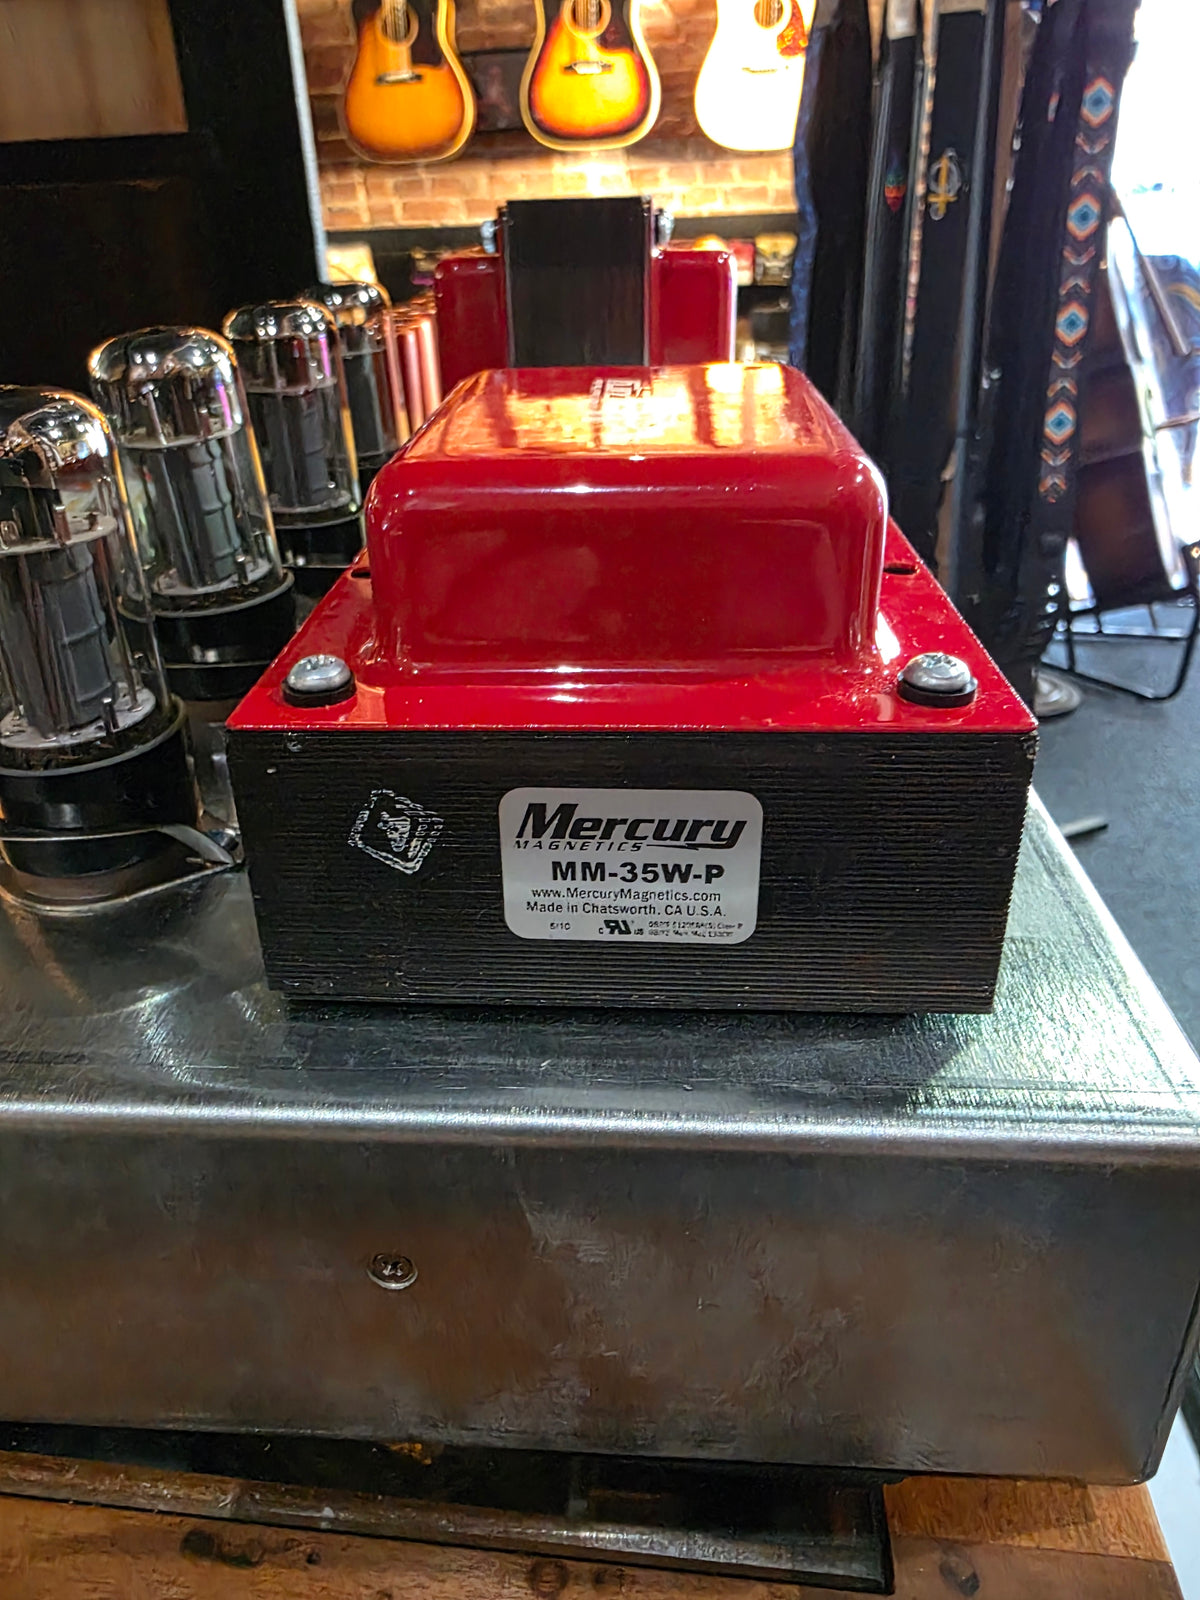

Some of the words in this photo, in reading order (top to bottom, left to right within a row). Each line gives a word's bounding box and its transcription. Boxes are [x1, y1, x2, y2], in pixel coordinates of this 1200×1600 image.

[516, 803, 747, 849] Mercury
[513, 840, 643, 852] MAGNETICS
[551, 861, 725, 884] MM-35W-P
[531, 888, 721, 902] www.MercuryMagnetics.com
[526, 901, 563, 913] Made
[567, 902, 578, 913] in
[664, 904, 683, 916] CA
